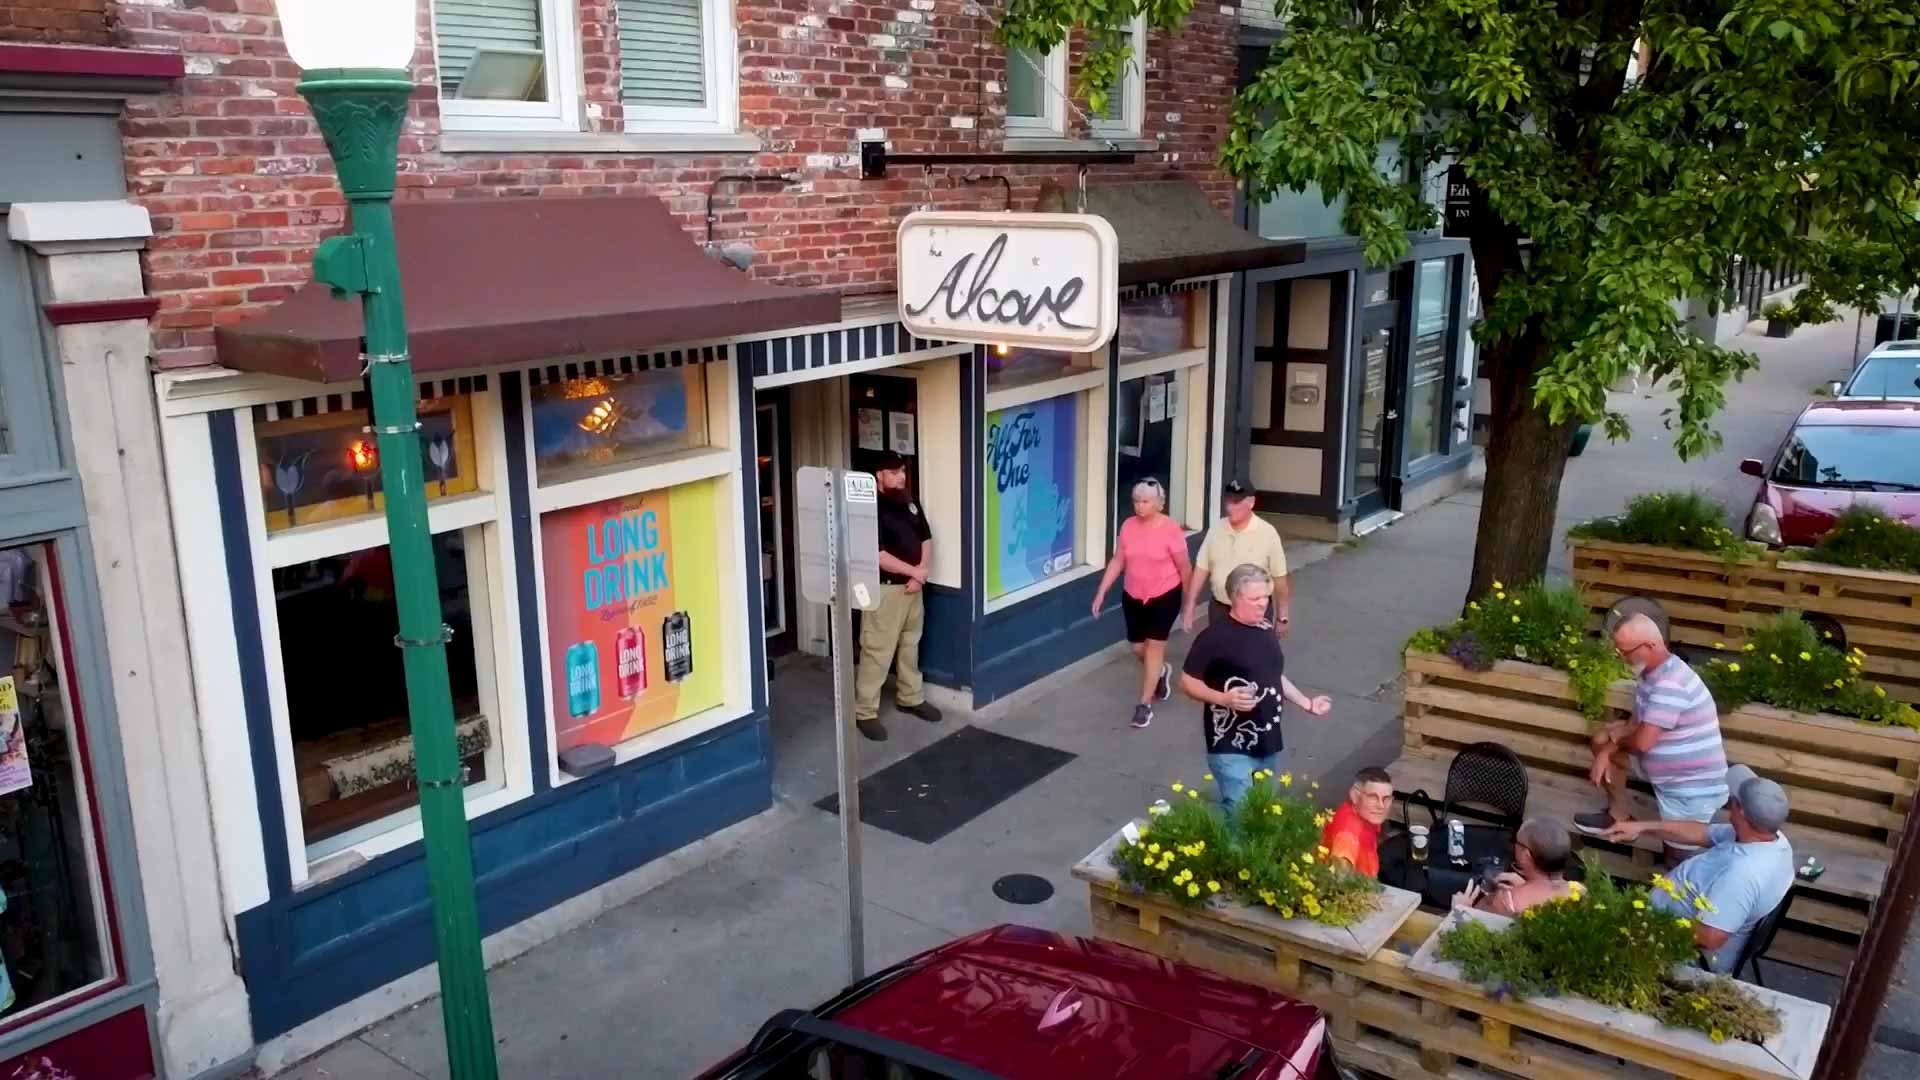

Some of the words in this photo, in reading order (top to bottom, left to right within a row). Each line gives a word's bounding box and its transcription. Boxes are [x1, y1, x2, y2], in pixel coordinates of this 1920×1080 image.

[905, 233, 1097, 330] Alcove
[1013, 411, 1041, 457] For
[997, 455, 1030, 493] One
[587, 511, 659, 565] LONG
[584, 551, 669, 612] DRINK
[619, 648, 642, 664] LONG
[665, 630, 689, 649] LONG
[665, 644, 691, 662] DRINK
[618, 661, 644, 679] DRINK
